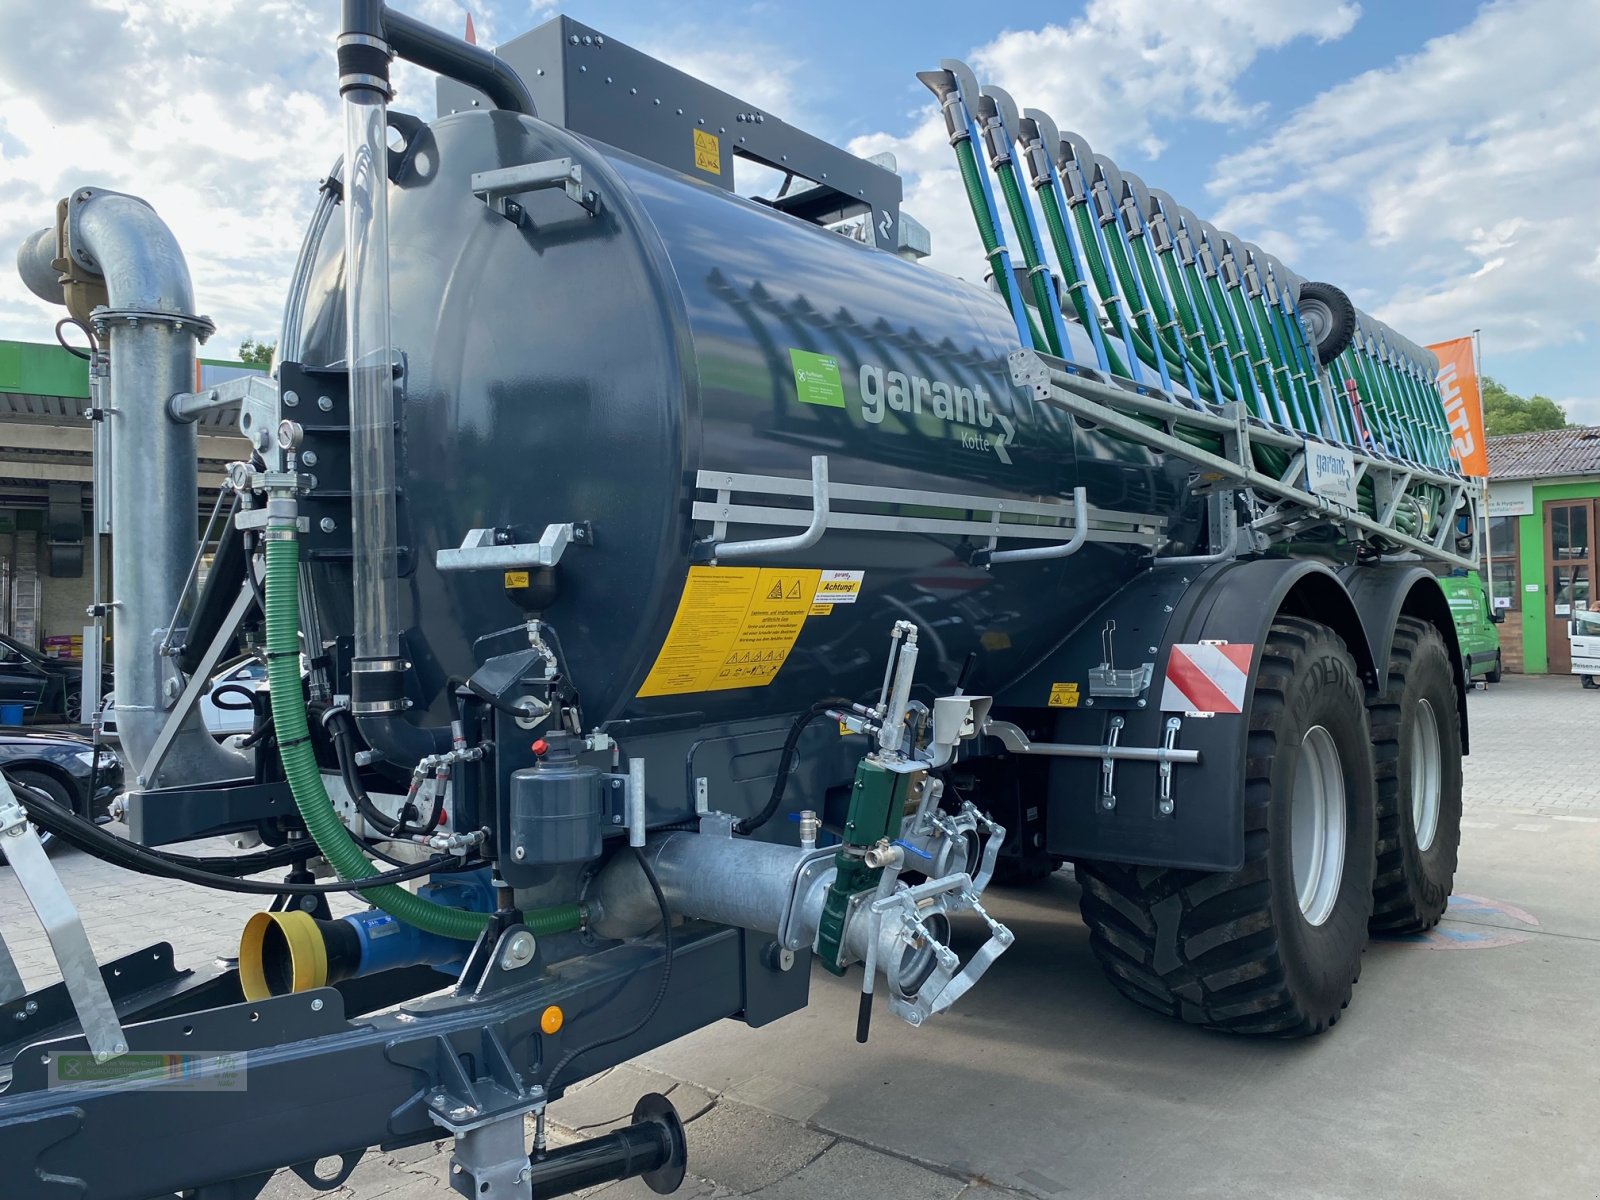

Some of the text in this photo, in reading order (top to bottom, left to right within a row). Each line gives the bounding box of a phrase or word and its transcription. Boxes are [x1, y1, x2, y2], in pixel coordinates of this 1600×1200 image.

[859, 363, 994, 428] garant
[961, 431, 990, 453] Kotte
[1316, 454, 1346, 478] garant
[824, 583, 855, 592] Achtung!
